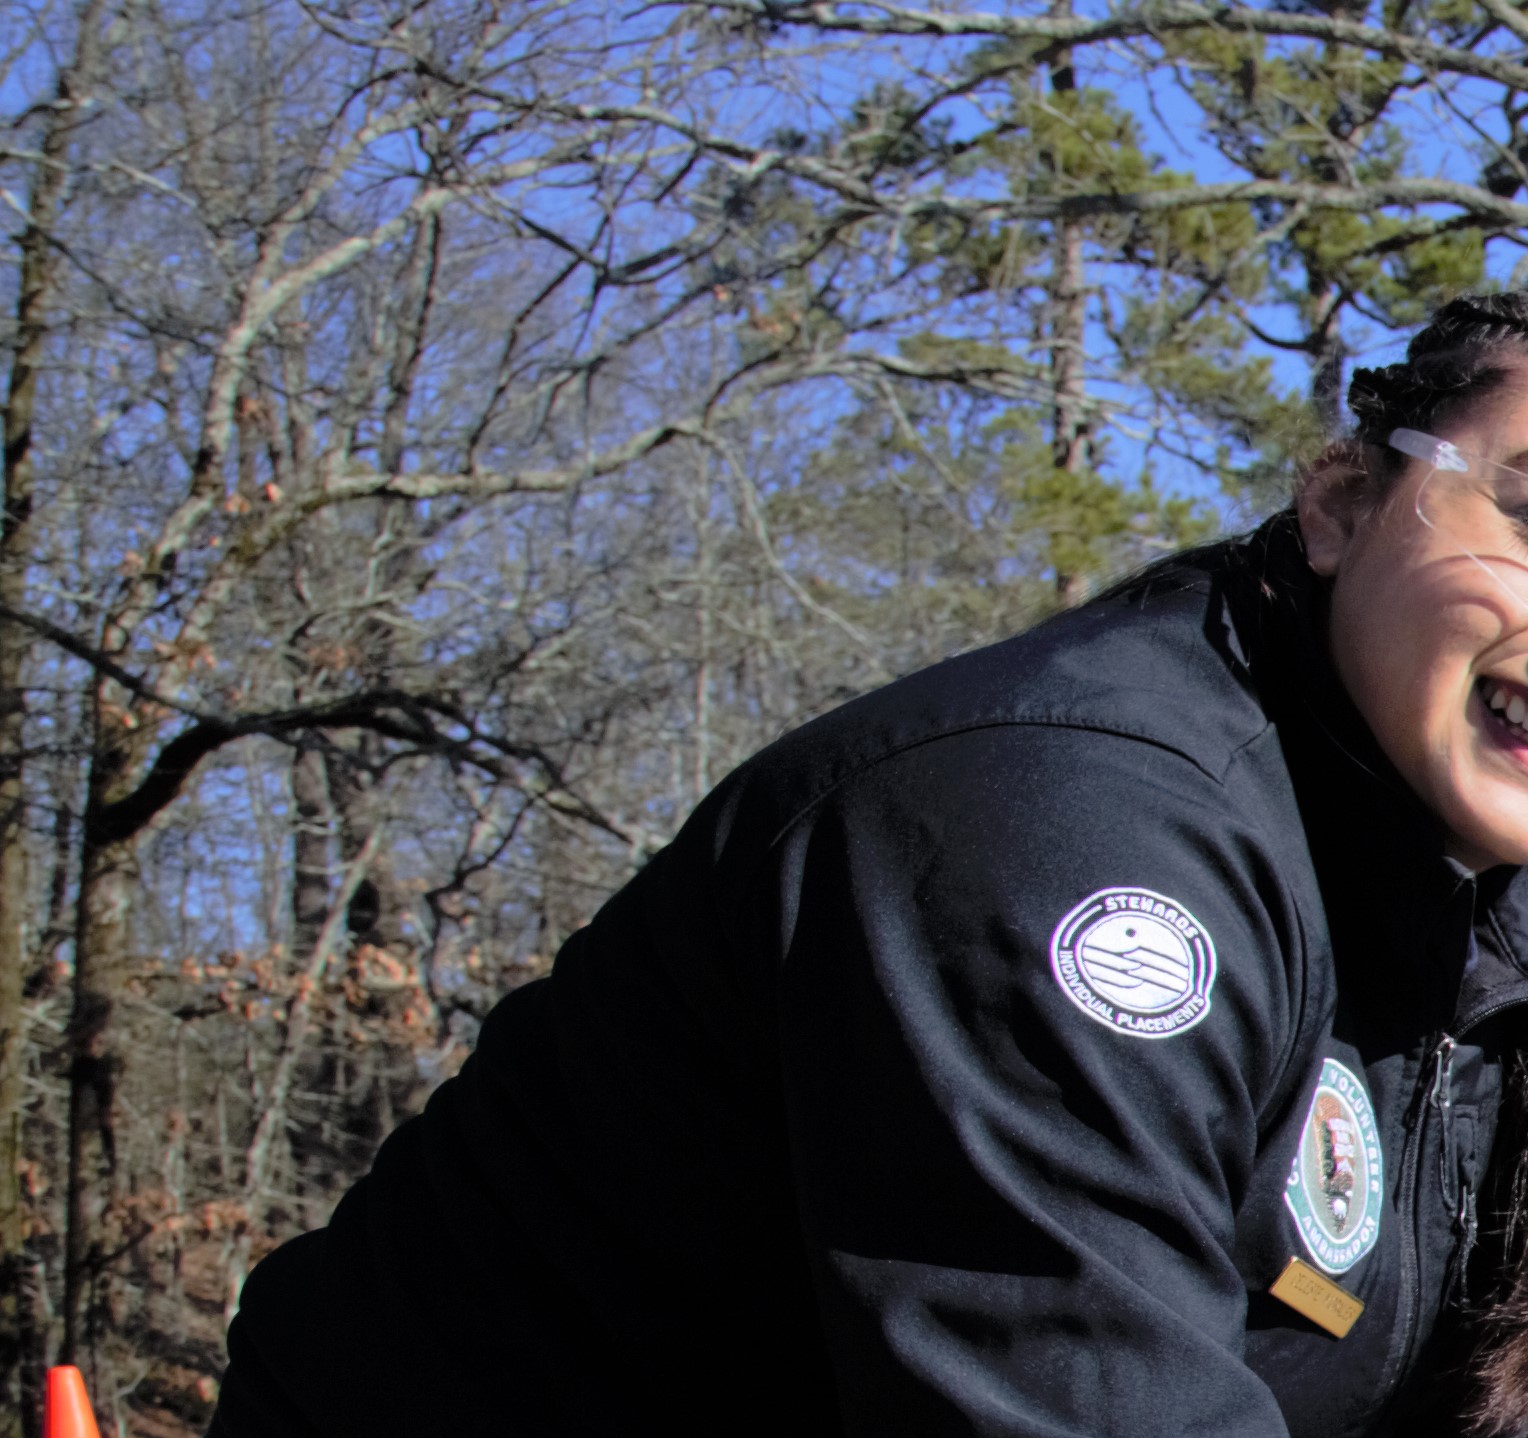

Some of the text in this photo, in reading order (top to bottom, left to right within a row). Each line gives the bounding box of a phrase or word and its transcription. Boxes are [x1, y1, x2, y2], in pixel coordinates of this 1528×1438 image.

[1104, 894, 1199, 939] STEWARDS
[1059, 950, 1205, 1032] INDIVIDUAL PLACEMENTS
[1328, 1067, 1382, 1194] VOLUNTEER
